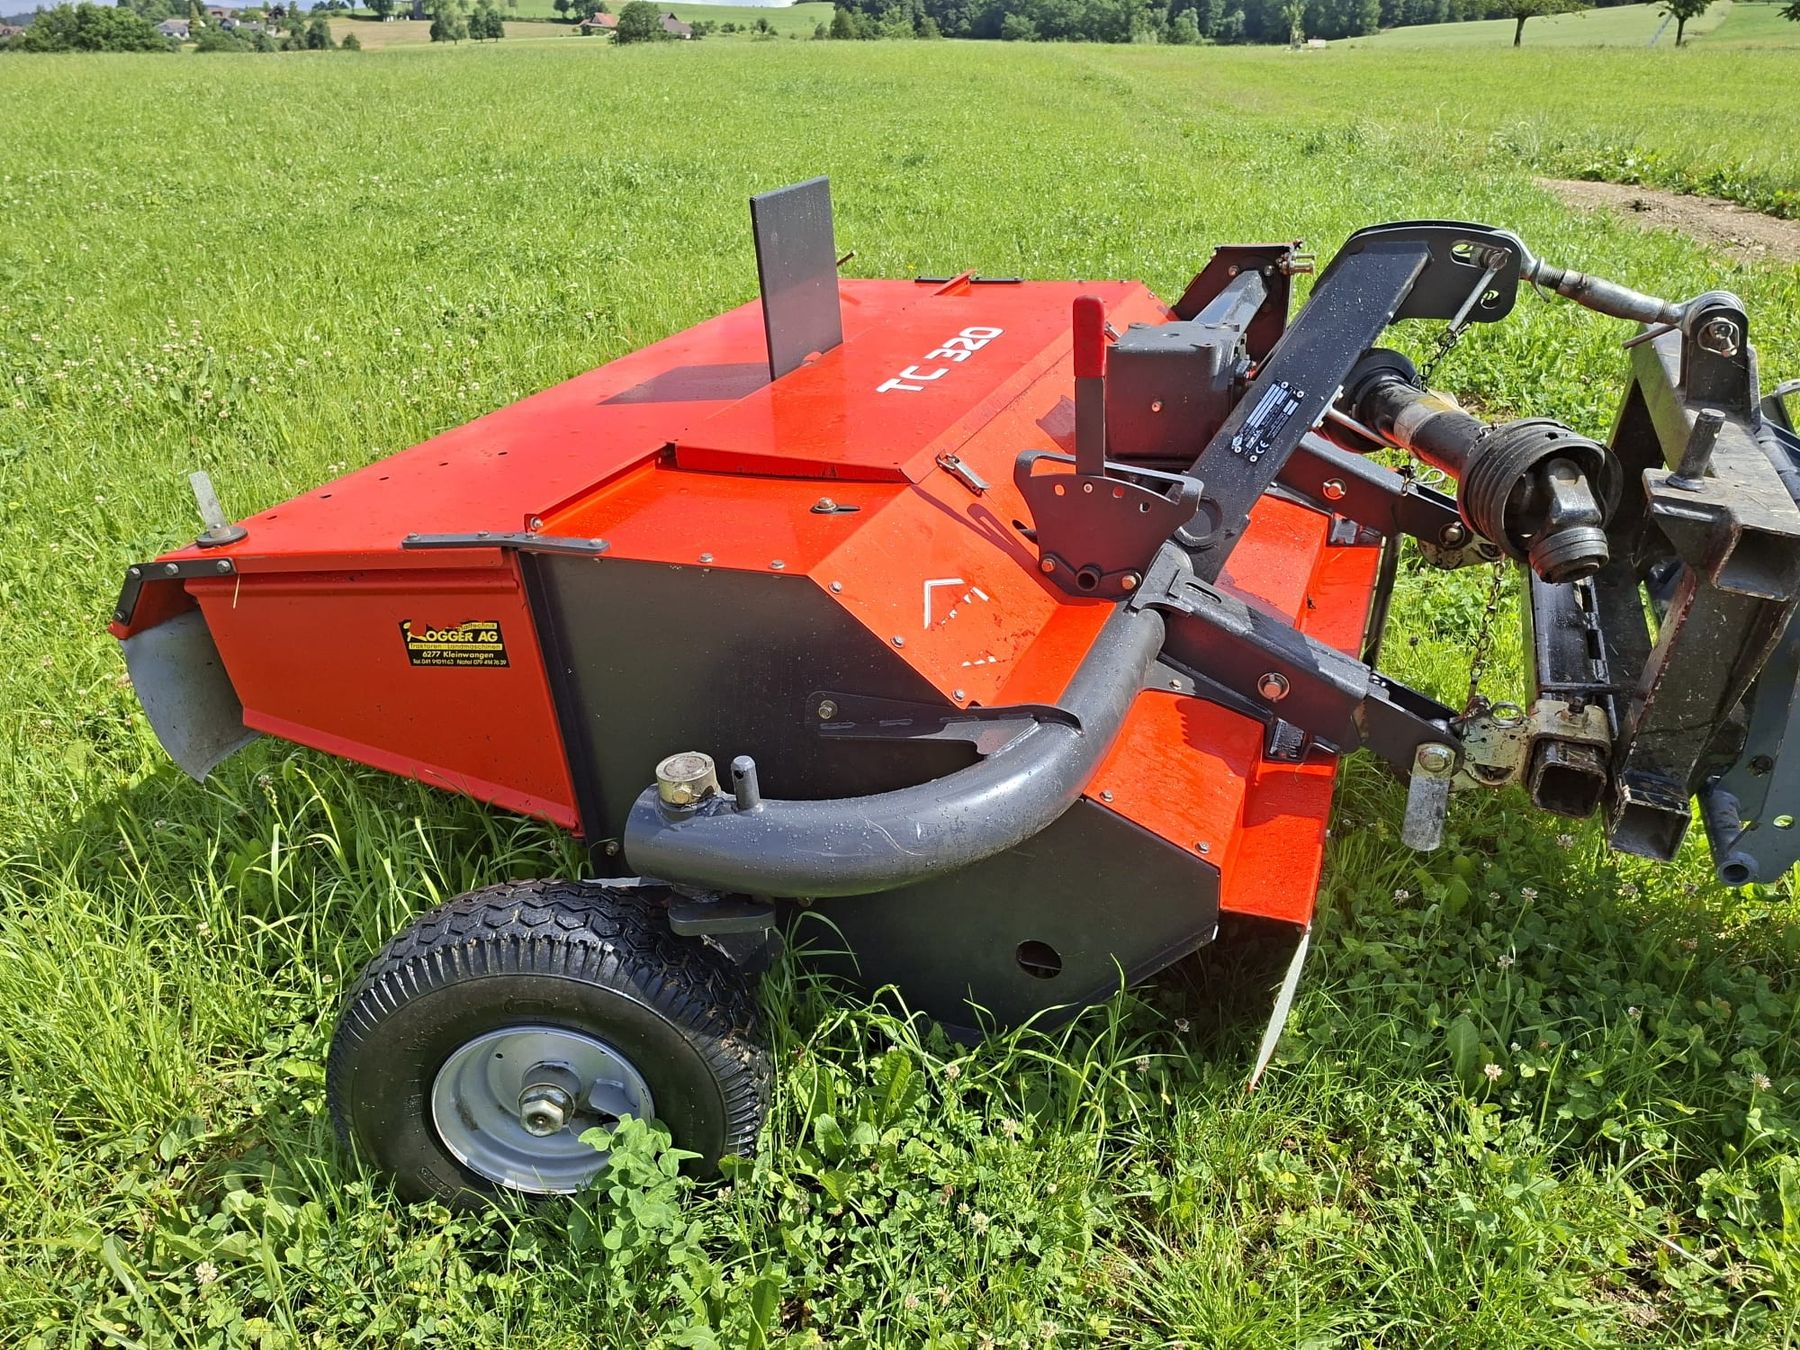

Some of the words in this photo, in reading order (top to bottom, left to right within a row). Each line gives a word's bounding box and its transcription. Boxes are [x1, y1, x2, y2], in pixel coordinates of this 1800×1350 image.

[876, 365, 950, 393] TC
[923, 326, 1004, 362] 320
[478, 631, 498, 642] AG
[422, 650, 441, 658] 6277
[443, 651, 494, 660] Kleinwangen
